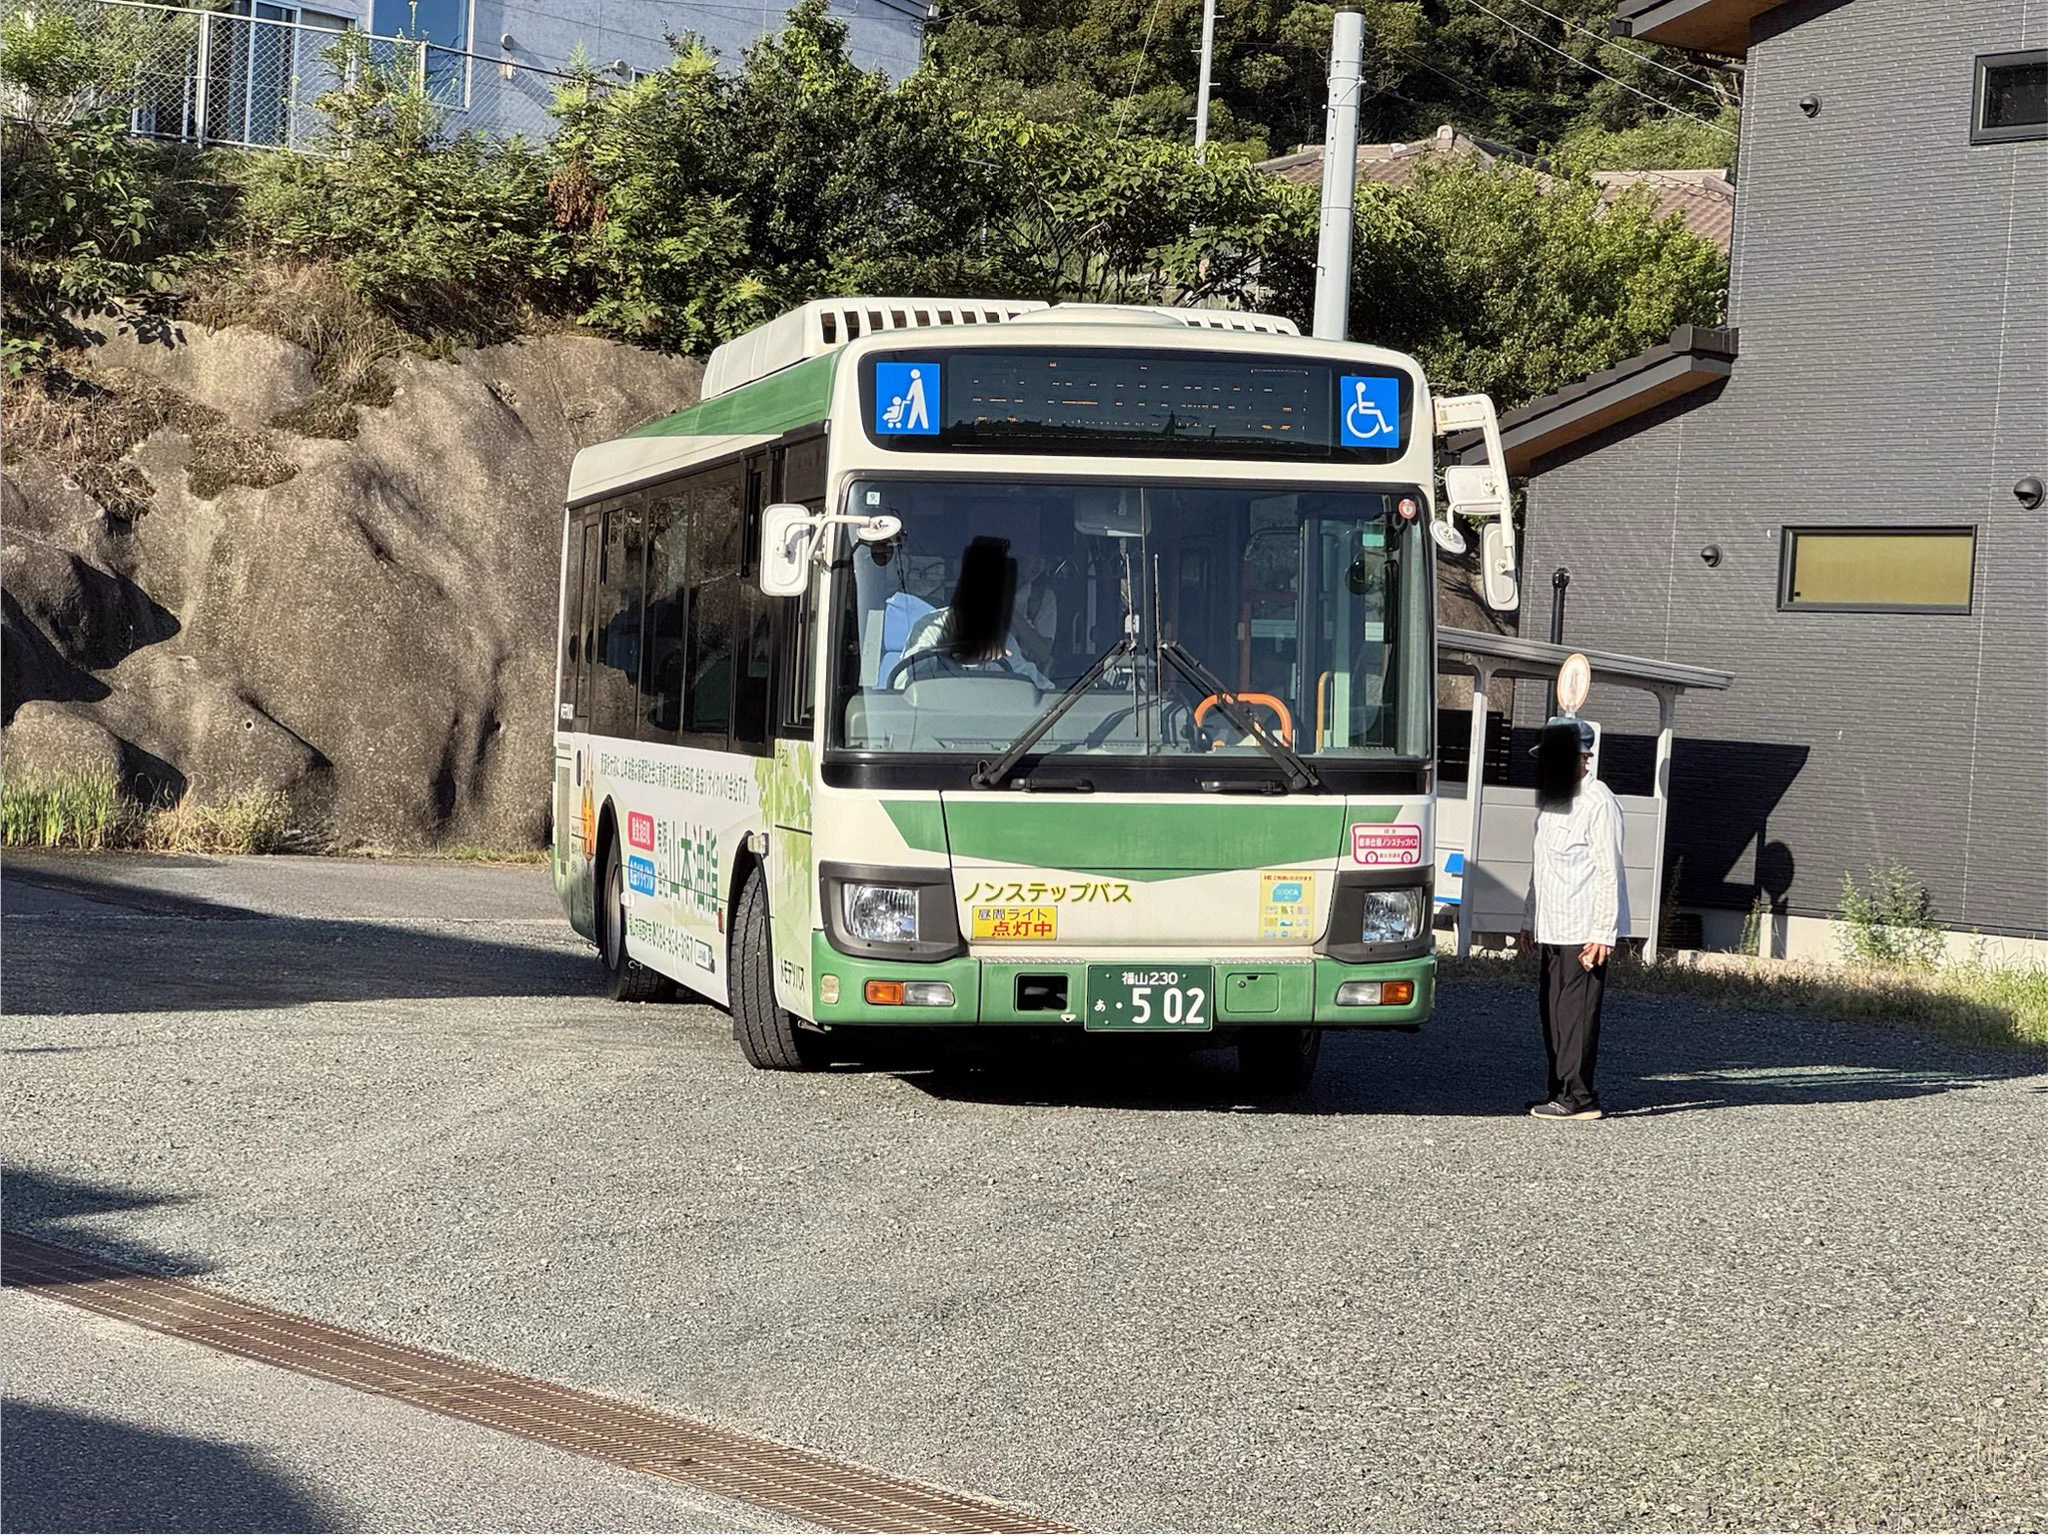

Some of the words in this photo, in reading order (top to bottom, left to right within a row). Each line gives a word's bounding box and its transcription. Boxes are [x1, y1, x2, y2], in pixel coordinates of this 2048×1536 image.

[668, 820, 719, 914] 山本油脂
[963, 882, 1132, 903] ノンステップバス
[978, 908, 1047, 921] 昼間ライト
[991, 921, 1052, 937] 点灯中
[1121, 971, 1178, 985] 福山230
[1094, 998, 1106, 1012] あ
